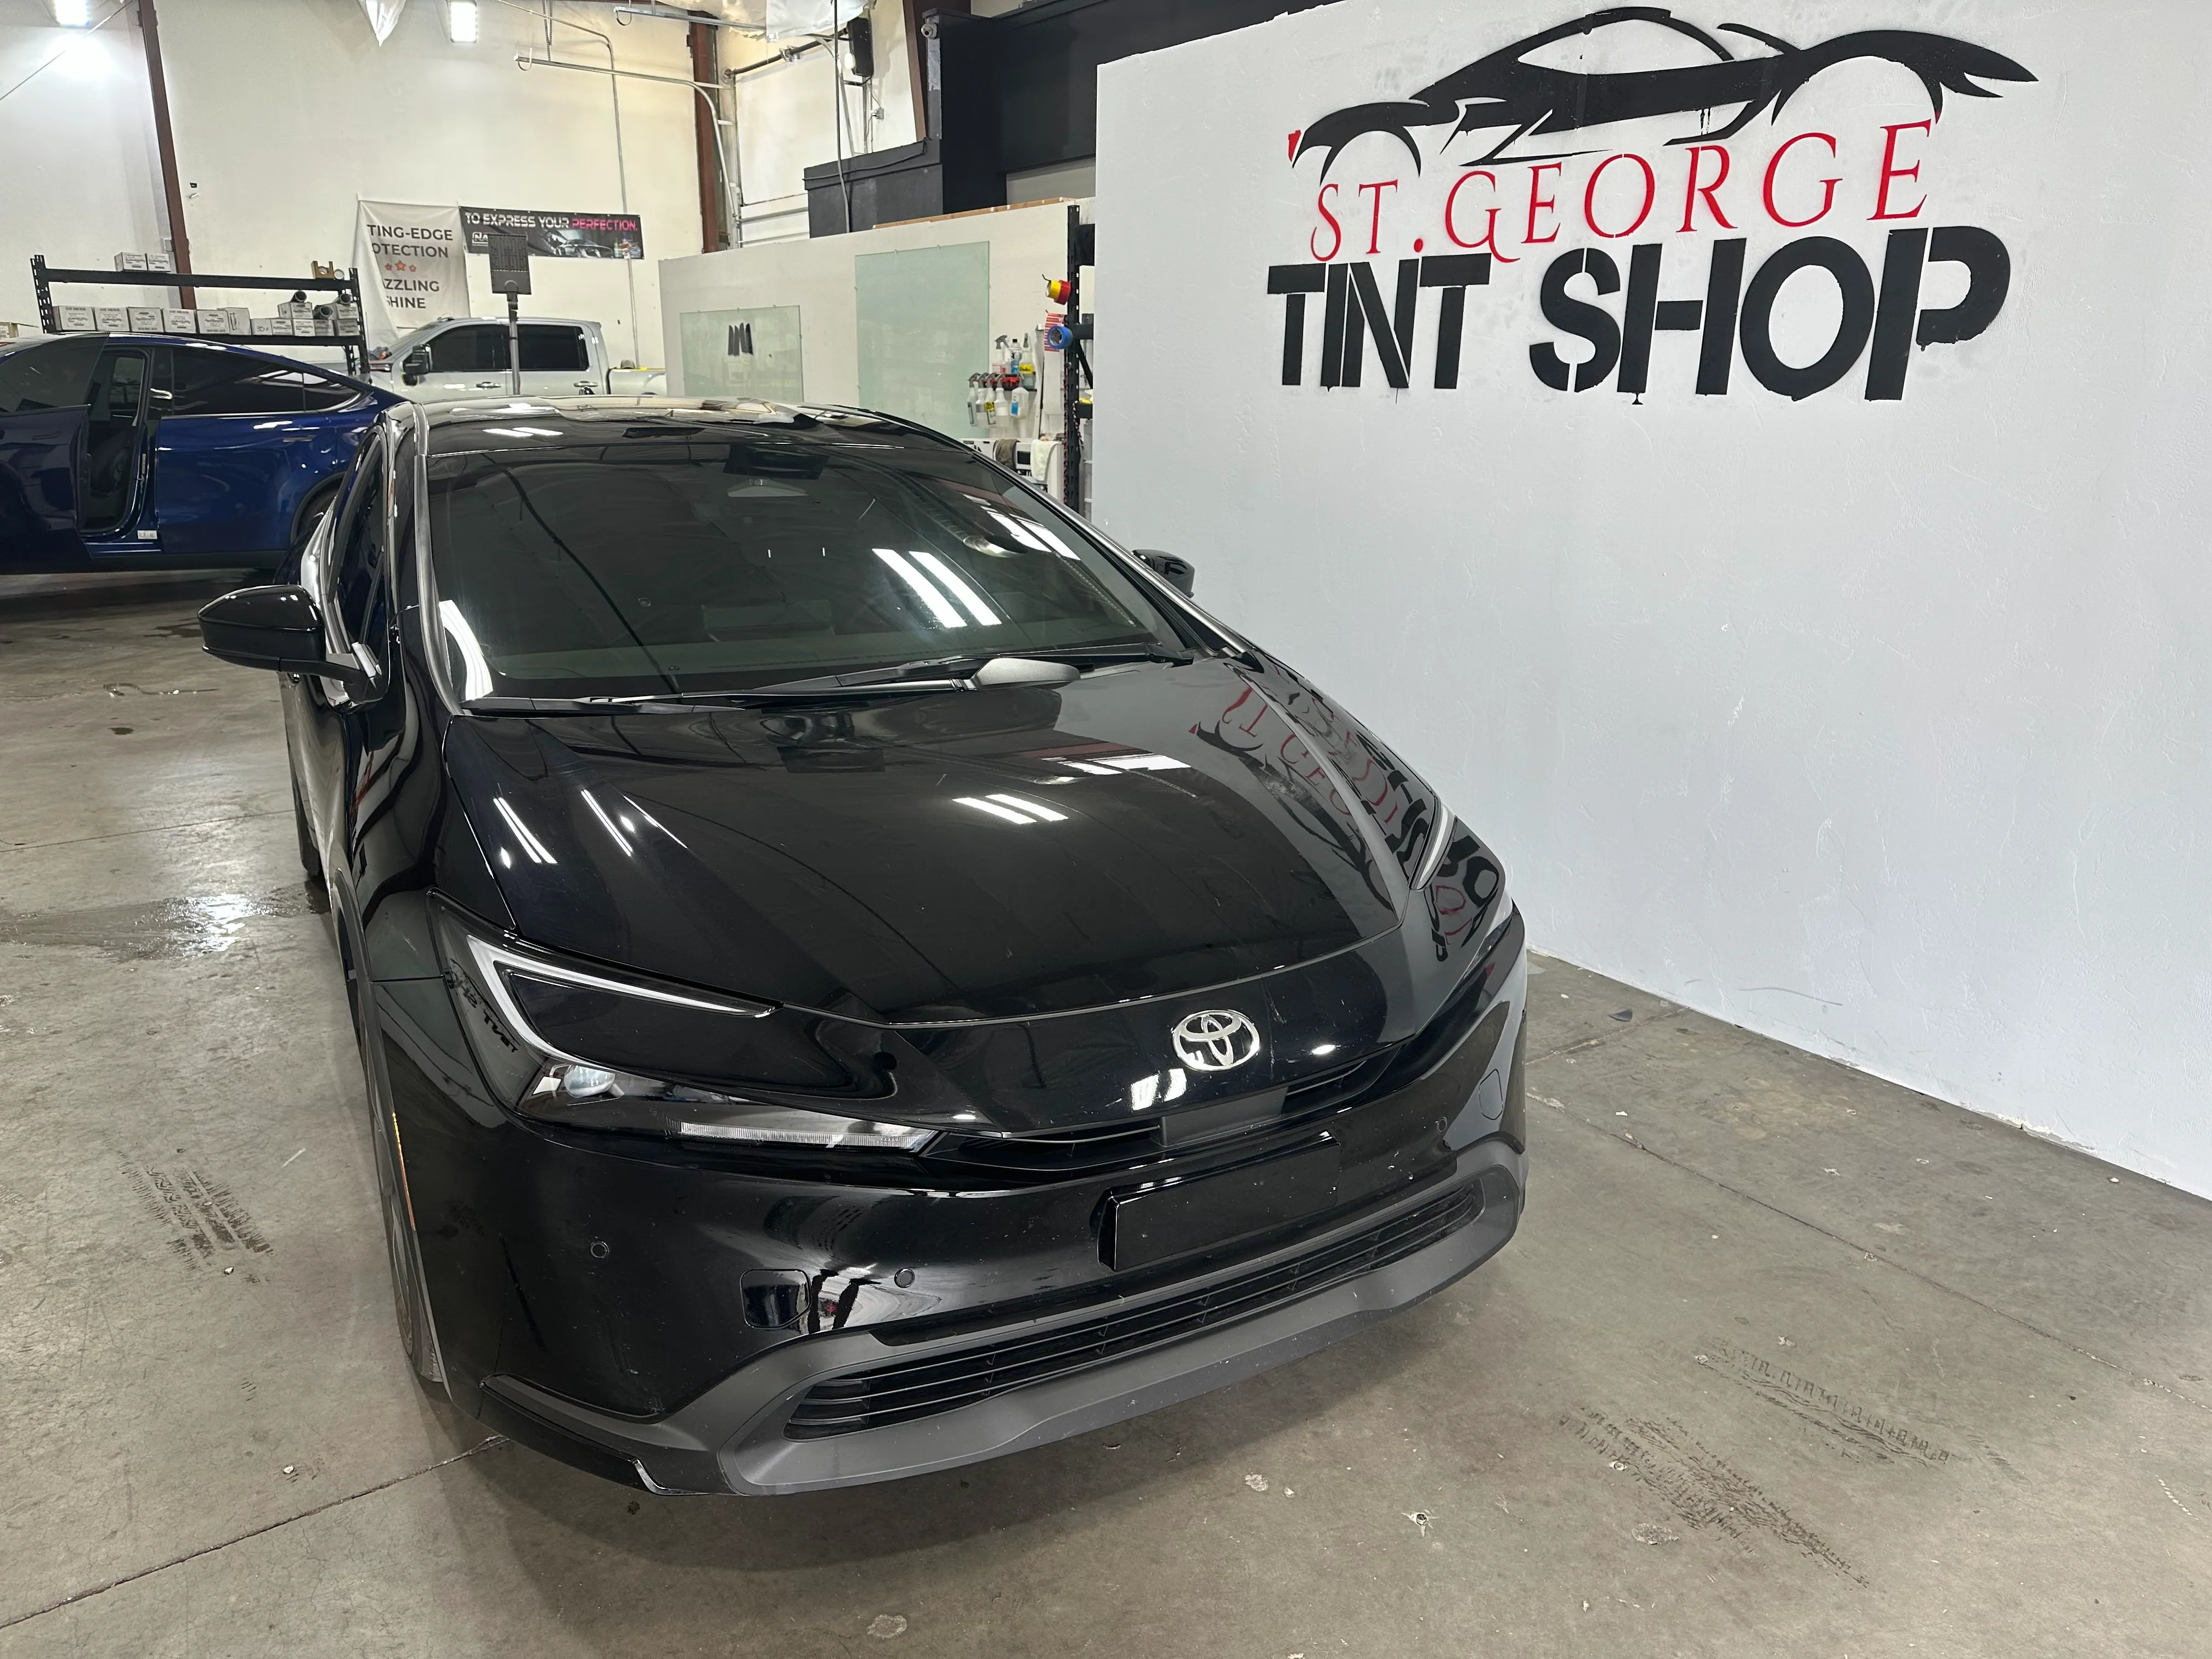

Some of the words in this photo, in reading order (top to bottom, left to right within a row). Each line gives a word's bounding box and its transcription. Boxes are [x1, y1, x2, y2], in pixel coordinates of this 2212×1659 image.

[465, 212, 481, 225] TO
[483, 213, 535, 228] EXPRESS
[538, 216, 569, 229] YOUR
[572, 217, 638, 231] PERFECTION.
[372, 242, 448, 258] OTECTION
[1267, 252, 1492, 391] TINT
[1528, 225, 2011, 403] SHOP
